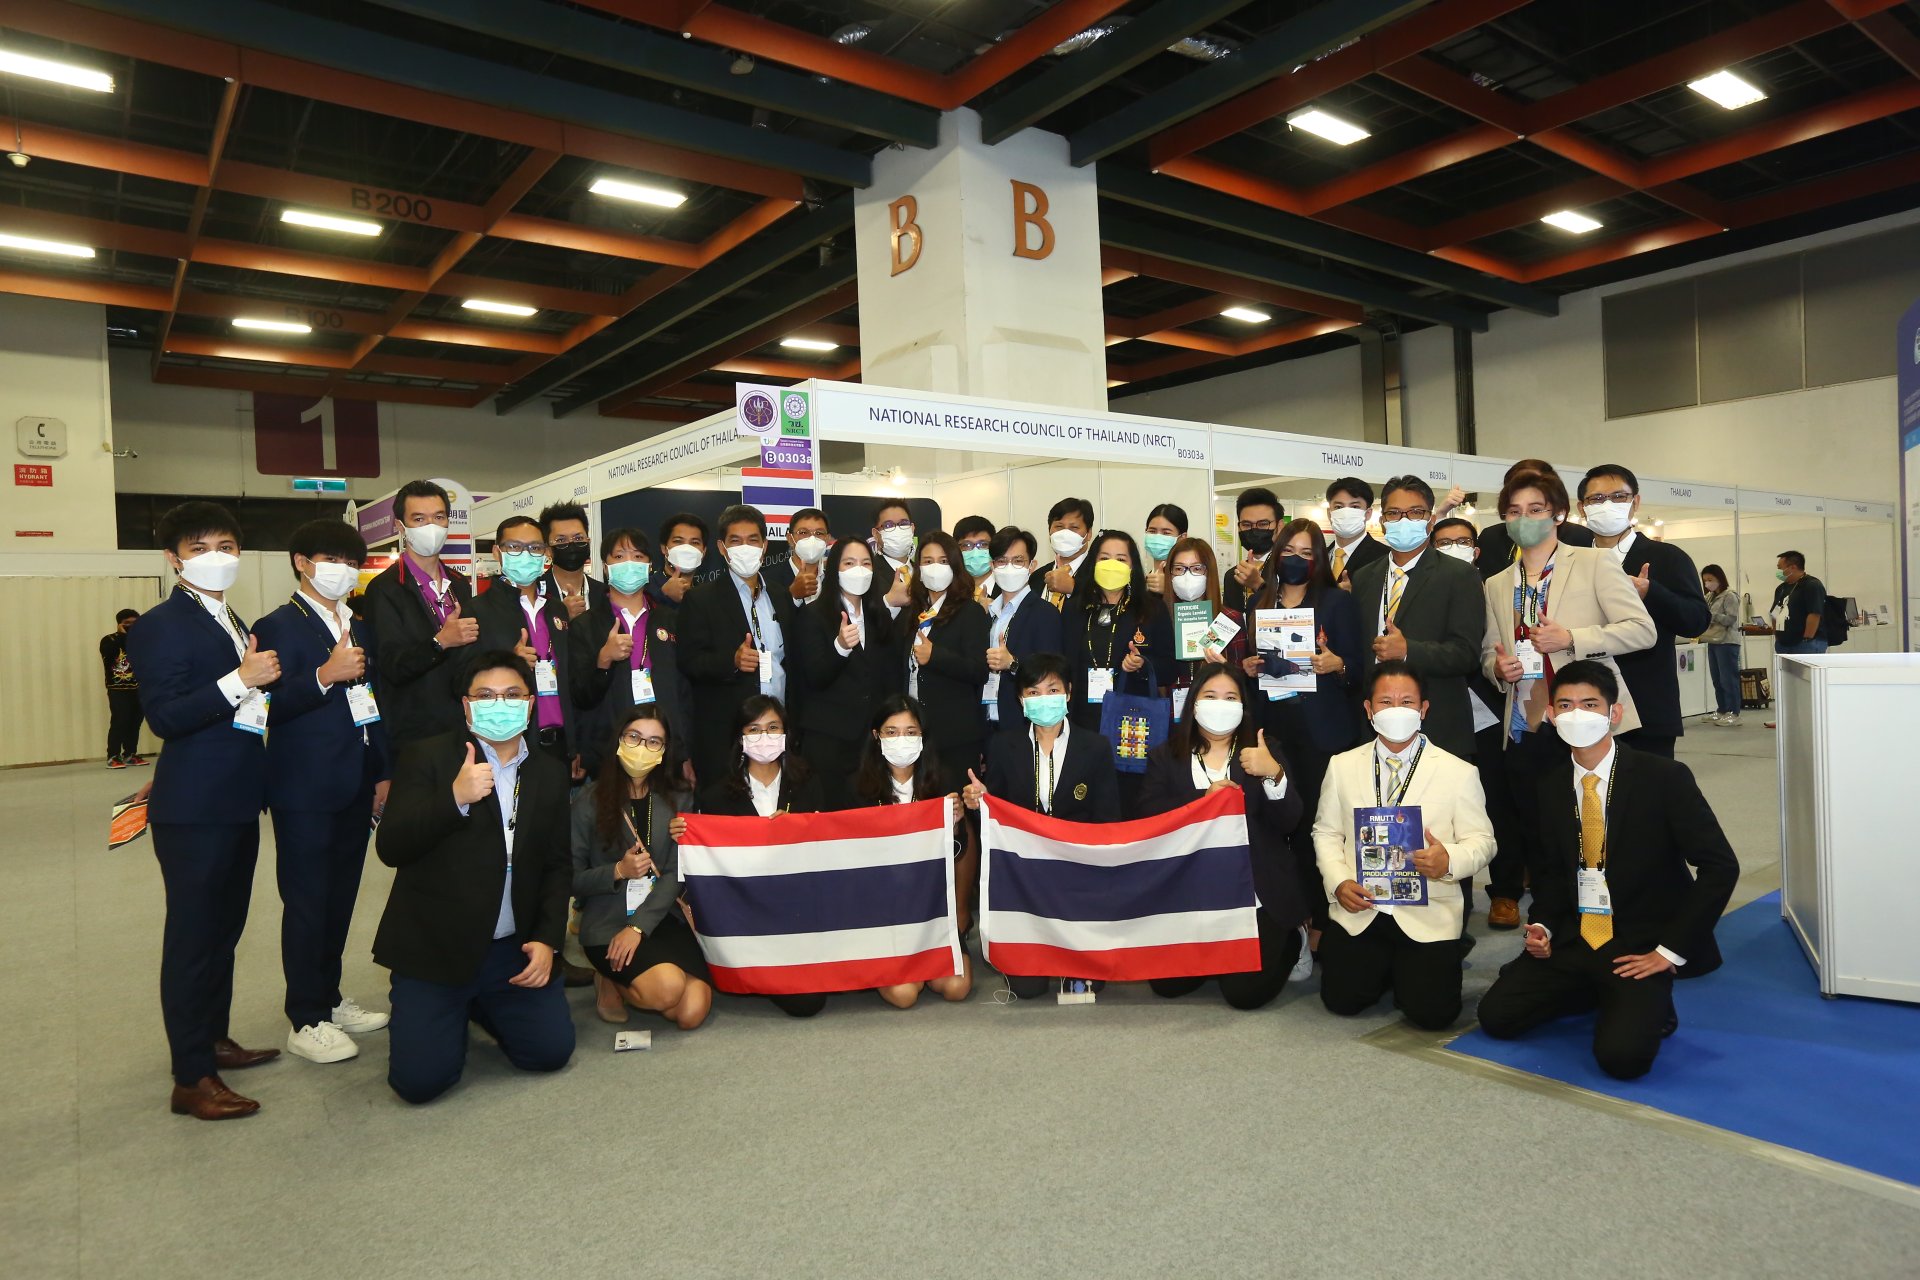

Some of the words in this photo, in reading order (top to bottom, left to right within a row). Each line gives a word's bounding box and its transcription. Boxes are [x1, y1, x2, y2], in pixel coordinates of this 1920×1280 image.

[351, 187, 432, 221] B200
[1010, 178, 1056, 260] B
[888, 194, 923, 277] B
[300, 395, 337, 470] 1
[869, 406, 941, 428] NATIONAL
[944, 414, 1009, 433] RESEARCH
[1012, 421, 1066, 438] COUNCIL
[1067, 427, 1083, 439] OF
[1085, 428, 1140, 445] THAILAND
[1142, 433, 1176, 450] (NRCT)
[607, 461, 637, 480] NATIONAL
[637, 447, 669, 472] RESEARCH
[669, 441, 700, 461] COUNCIL
[700, 436, 710, 451] OF
[711, 427, 746, 447] THAILA
[1177, 448, 1204, 461] B0303a
[1321, 452, 1364, 468] THAILAND
[512, 495, 534, 512] THAILAND
[1670, 487, 1692, 498] THAILAND
